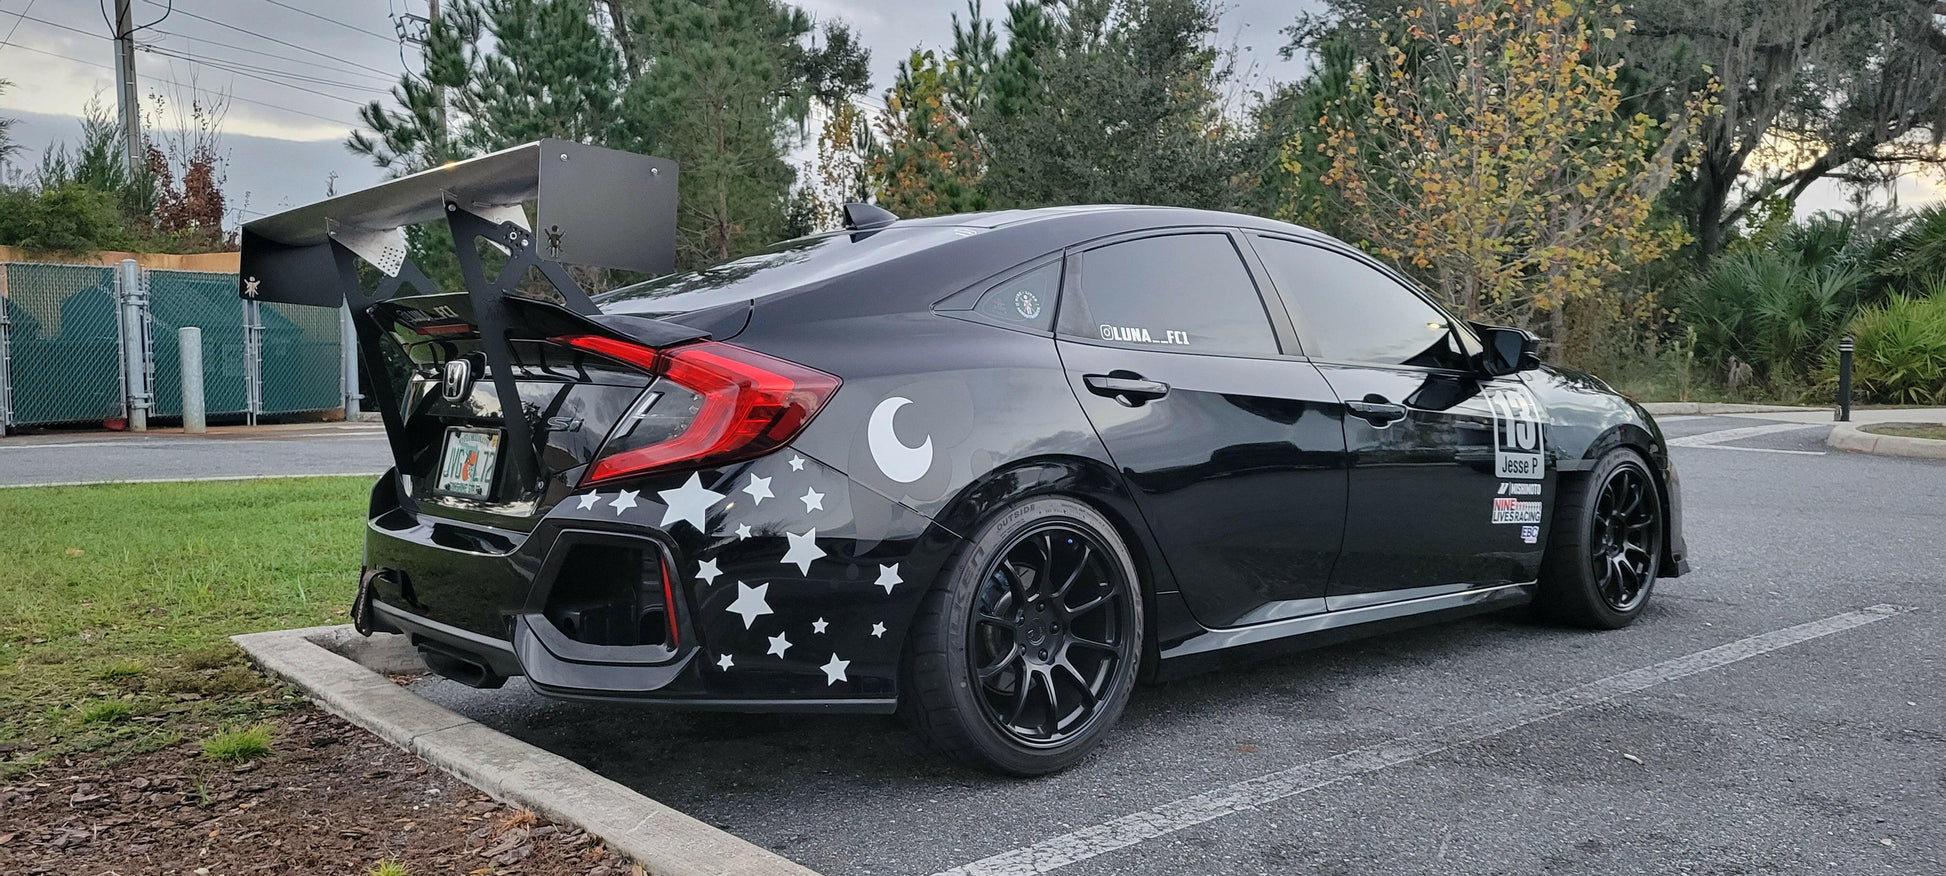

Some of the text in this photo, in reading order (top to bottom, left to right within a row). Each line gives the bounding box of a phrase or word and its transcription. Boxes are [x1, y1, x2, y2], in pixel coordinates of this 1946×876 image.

[1493, 390, 1536, 450] 13
[473, 450, 495, 483] L72
[1502, 456, 1538, 474] Jesse P
[996, 504, 1035, 531] OUTSIDE
[1494, 499, 1516, 511] NINE
